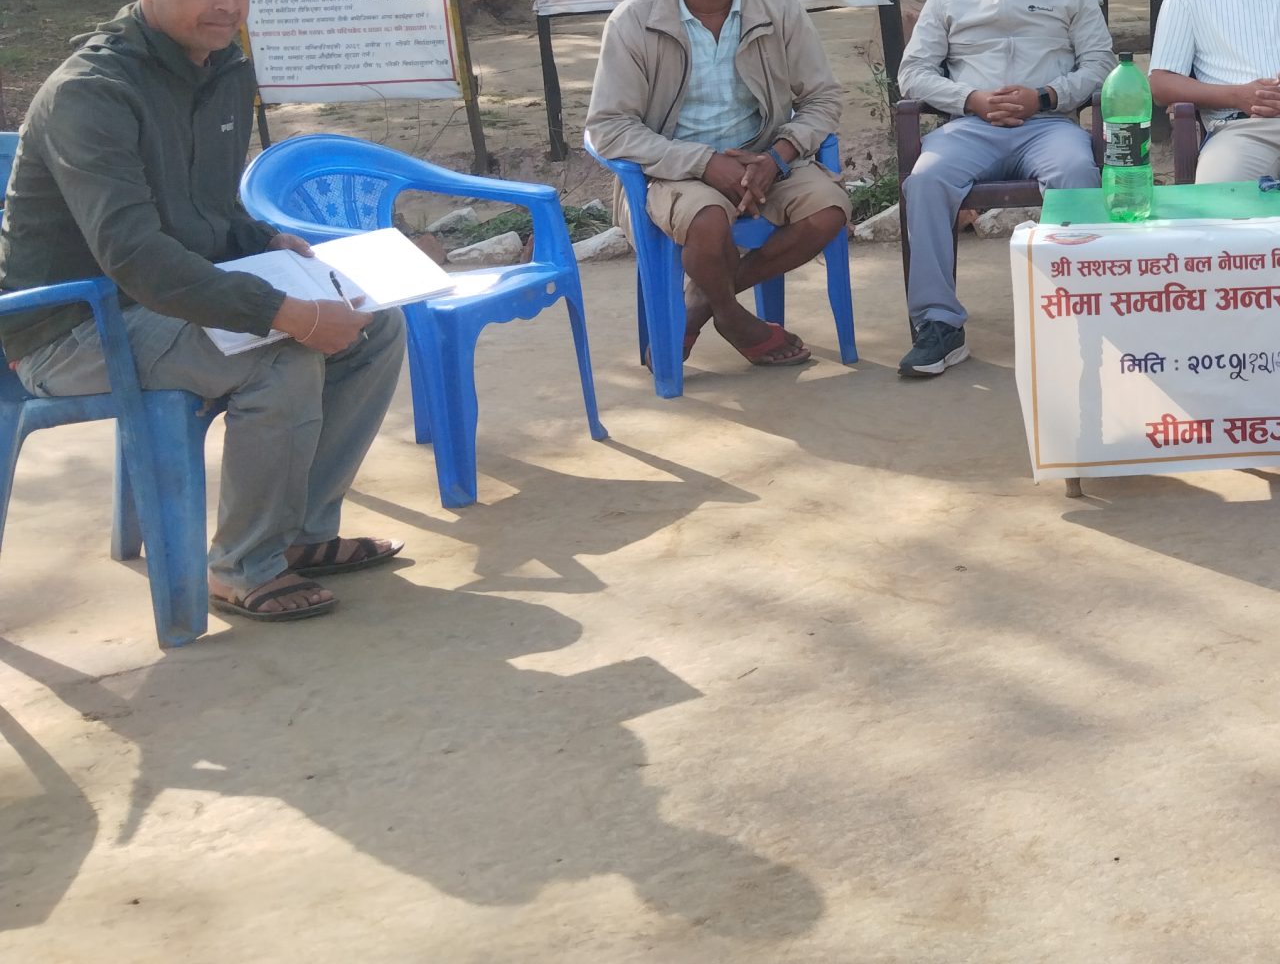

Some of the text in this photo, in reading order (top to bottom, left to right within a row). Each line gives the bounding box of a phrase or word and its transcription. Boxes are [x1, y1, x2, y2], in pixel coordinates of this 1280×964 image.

[1051, 256, 1071, 277] श्री
[1077, 259, 1131, 276] सशस्त्र
[1138, 252, 1179, 275] प्रहरी
[1185, 253, 1212, 273] बल
[1219, 250, 1265, 271] नेपाल
[1041, 287, 1101, 319] सीमा
[1112, 282, 1206, 313] सम्वन्धि
[1121, 351, 1166, 374] मिति
[1146, 414, 1214, 448] सीमा
